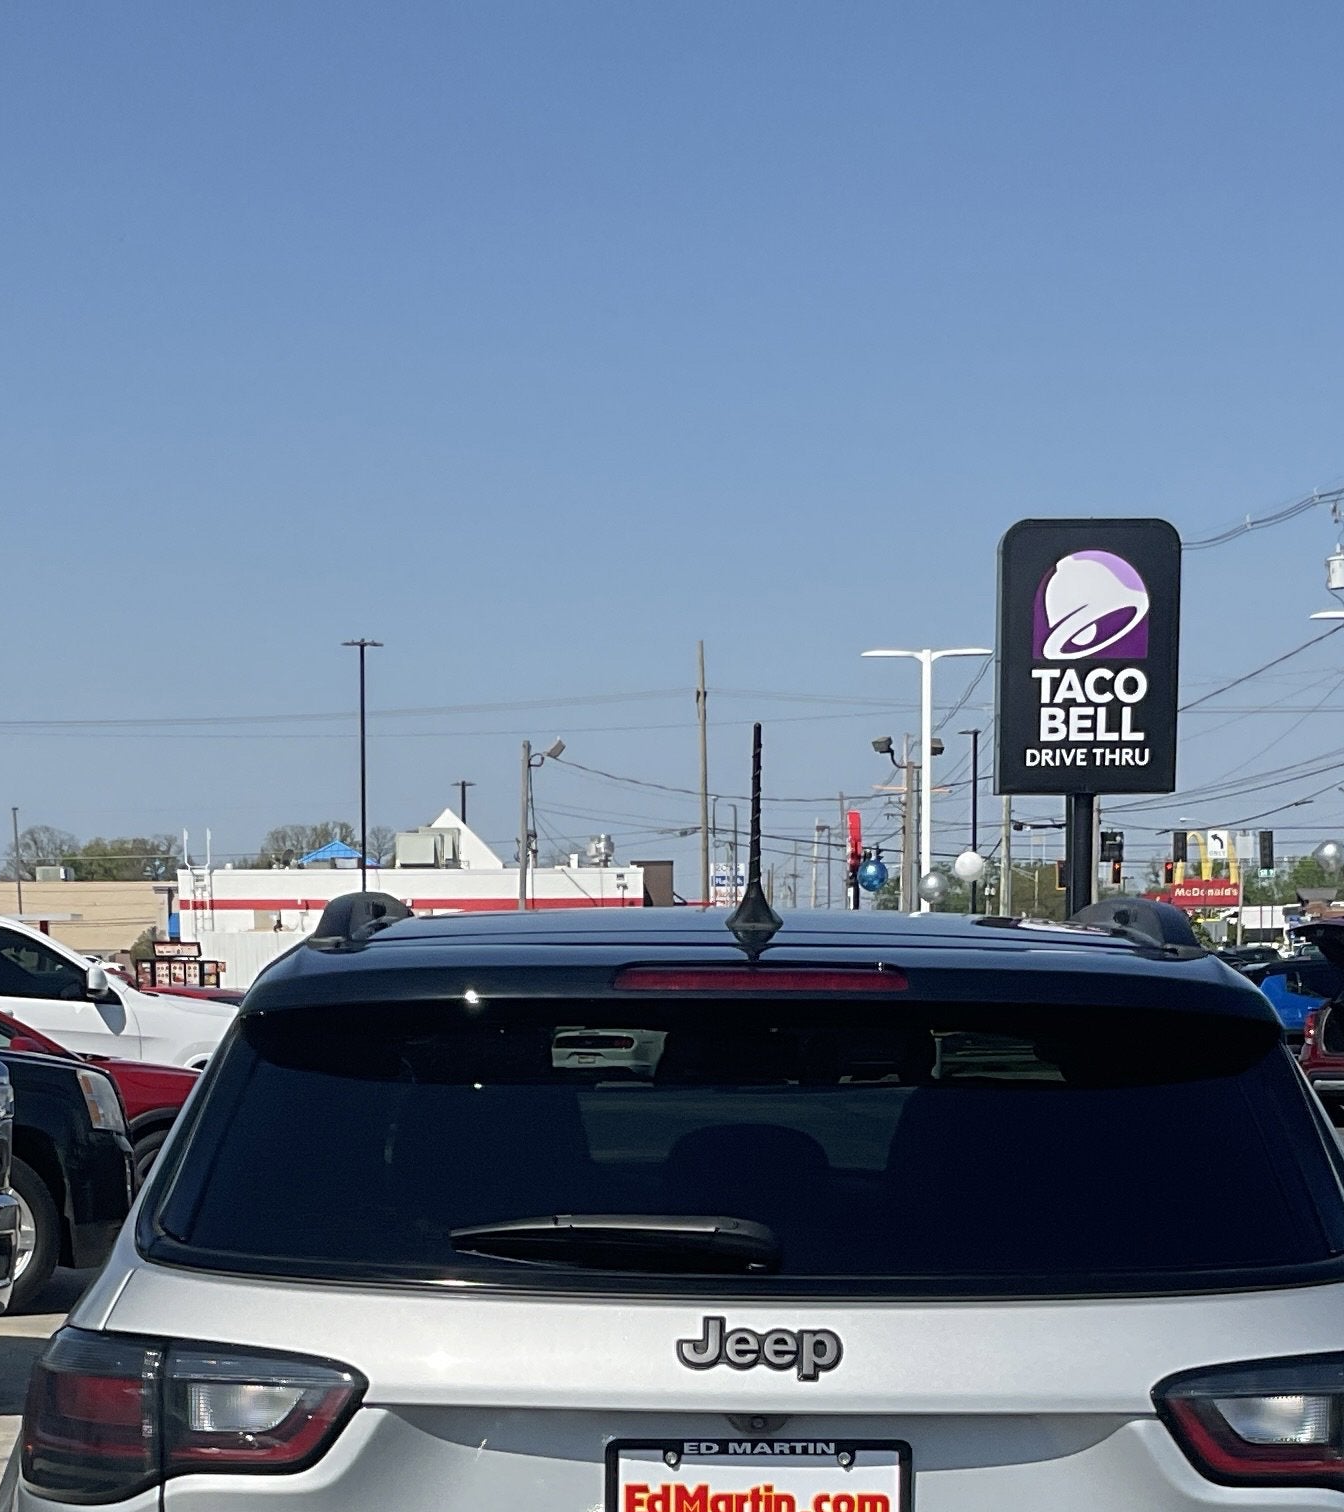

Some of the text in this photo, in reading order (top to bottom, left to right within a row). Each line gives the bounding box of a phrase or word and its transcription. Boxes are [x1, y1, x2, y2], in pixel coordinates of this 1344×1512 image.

[1031, 667, 1148, 704] TACO
[1039, 706, 1145, 742] BELL
[1025, 747, 1150, 768] DRIVE THRU
[1174, 887, 1239, 897] McDonald's
[675, 1315, 844, 1382] Jeep
[683, 1441, 836, 1455] ED MARTIN
